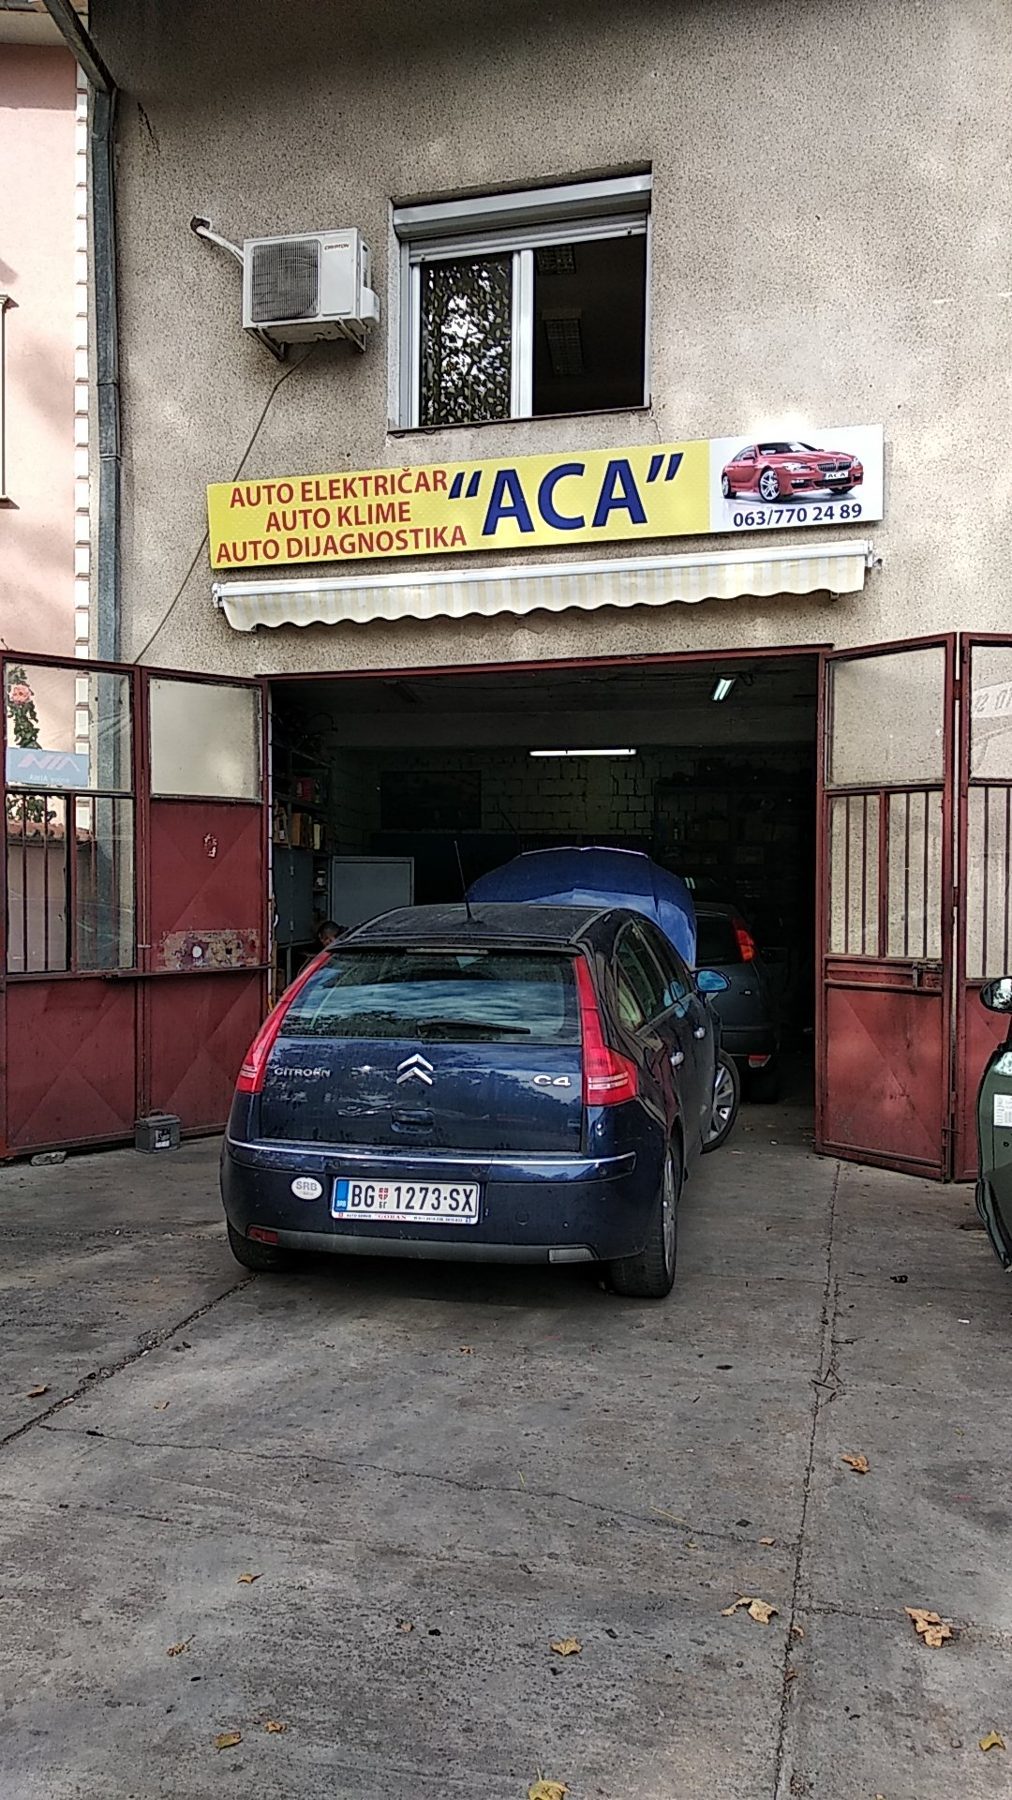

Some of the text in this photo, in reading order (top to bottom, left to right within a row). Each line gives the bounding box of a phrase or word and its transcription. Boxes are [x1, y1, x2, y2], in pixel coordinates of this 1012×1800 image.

[230, 468, 447, 509] AUTO ELEKTRIČAR
[264, 502, 412, 532] AUTO KLIME
[733, 502, 863, 528] 063/770 24 89
[216, 526, 466, 563] AUTO DIJAGNOSTIKA
[533, 1074, 572, 1088] C4
[295, 1180, 319, 1192] SRB
[351, 1184, 376, 1208] BG
